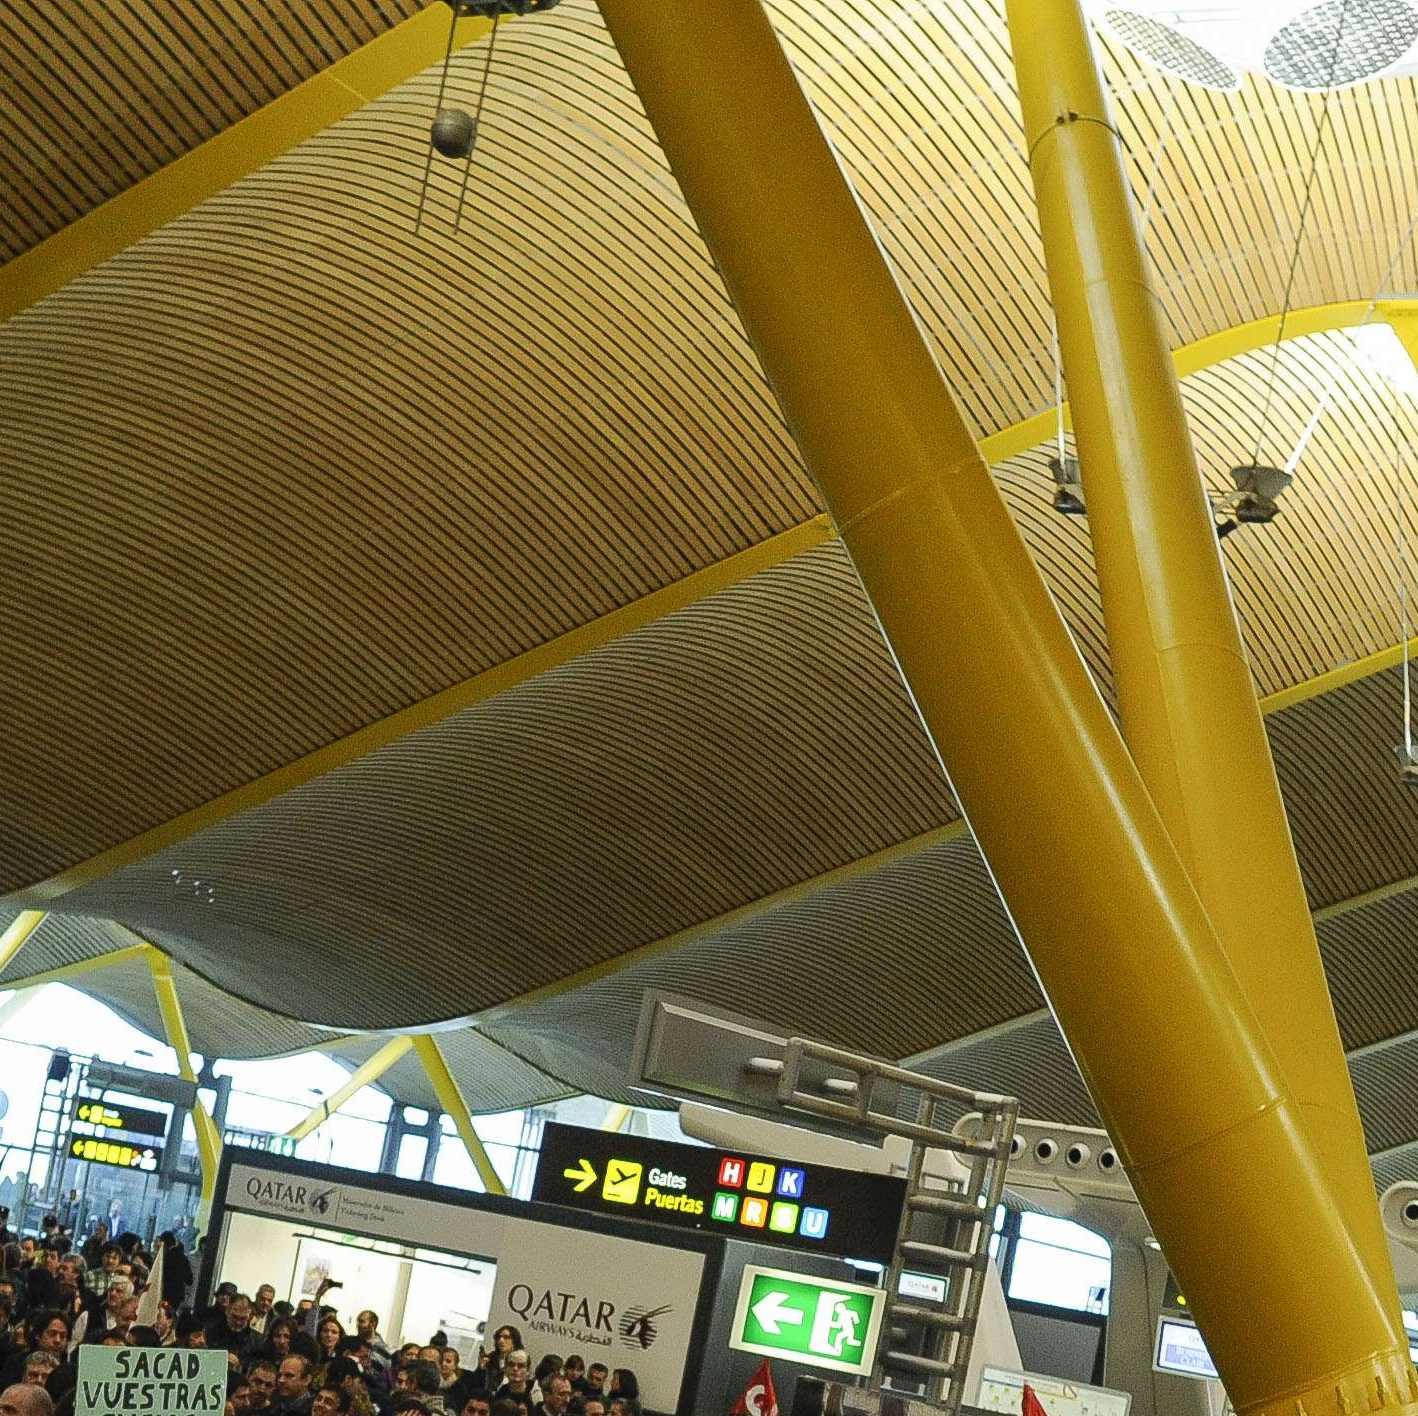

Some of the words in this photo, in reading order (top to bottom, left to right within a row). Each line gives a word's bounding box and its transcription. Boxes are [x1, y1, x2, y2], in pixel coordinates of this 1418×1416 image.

[246, 1177, 307, 1205] QATAR
[648, 1168, 687, 1190] Gates
[722, 1162, 741, 1184] H
[781, 1171, 799, 1194] K
[645, 1187, 704, 1215] Puertas
[714, 1196, 735, 1219] M
[745, 1201, 762, 1224] R
[776, 1206, 793, 1229] S
[806, 1211, 824, 1233] U
[507, 1284, 616, 1333] QATAR
[529, 1320, 575, 1339] AIRWAYS
[114, 1350, 200, 1380] SACAD
[82, 1381, 223, 1411] VUESTRAS
